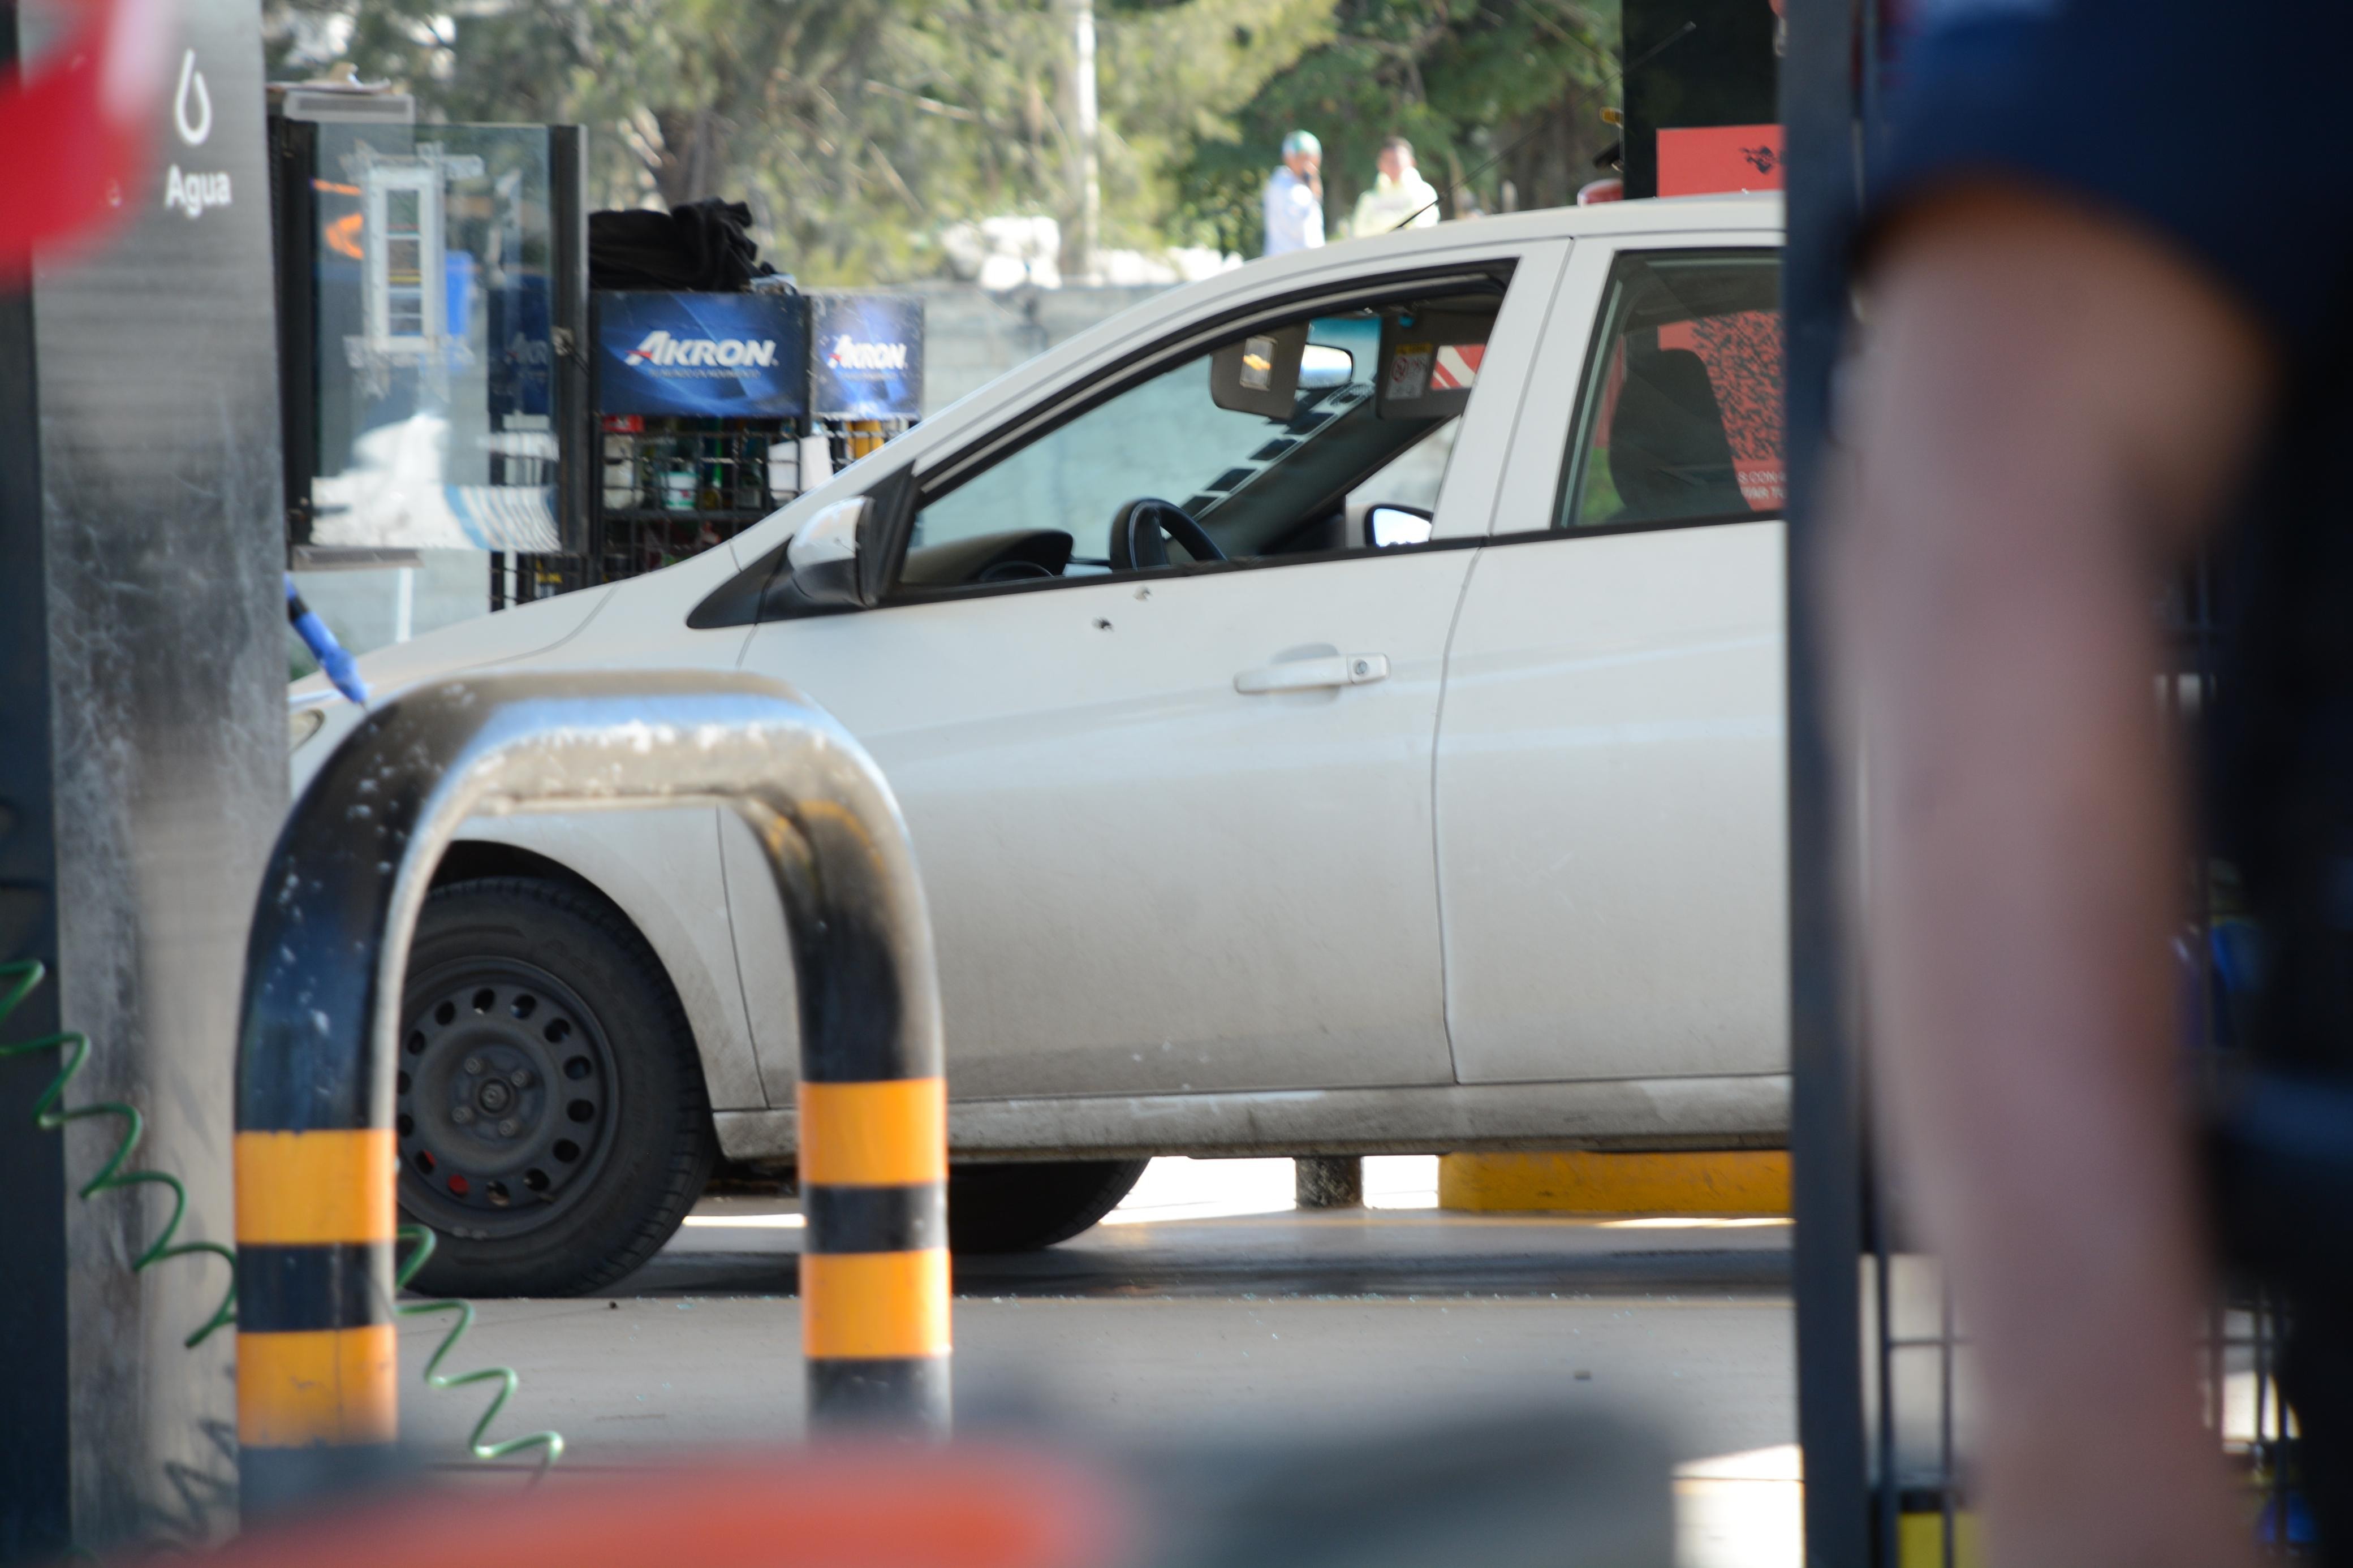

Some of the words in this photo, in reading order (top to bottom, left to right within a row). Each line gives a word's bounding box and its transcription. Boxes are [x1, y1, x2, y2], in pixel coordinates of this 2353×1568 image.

[165, 163, 232, 218] Agua
[624, 331, 775, 366] AKRON
[828, 335, 907, 369] AKRON
